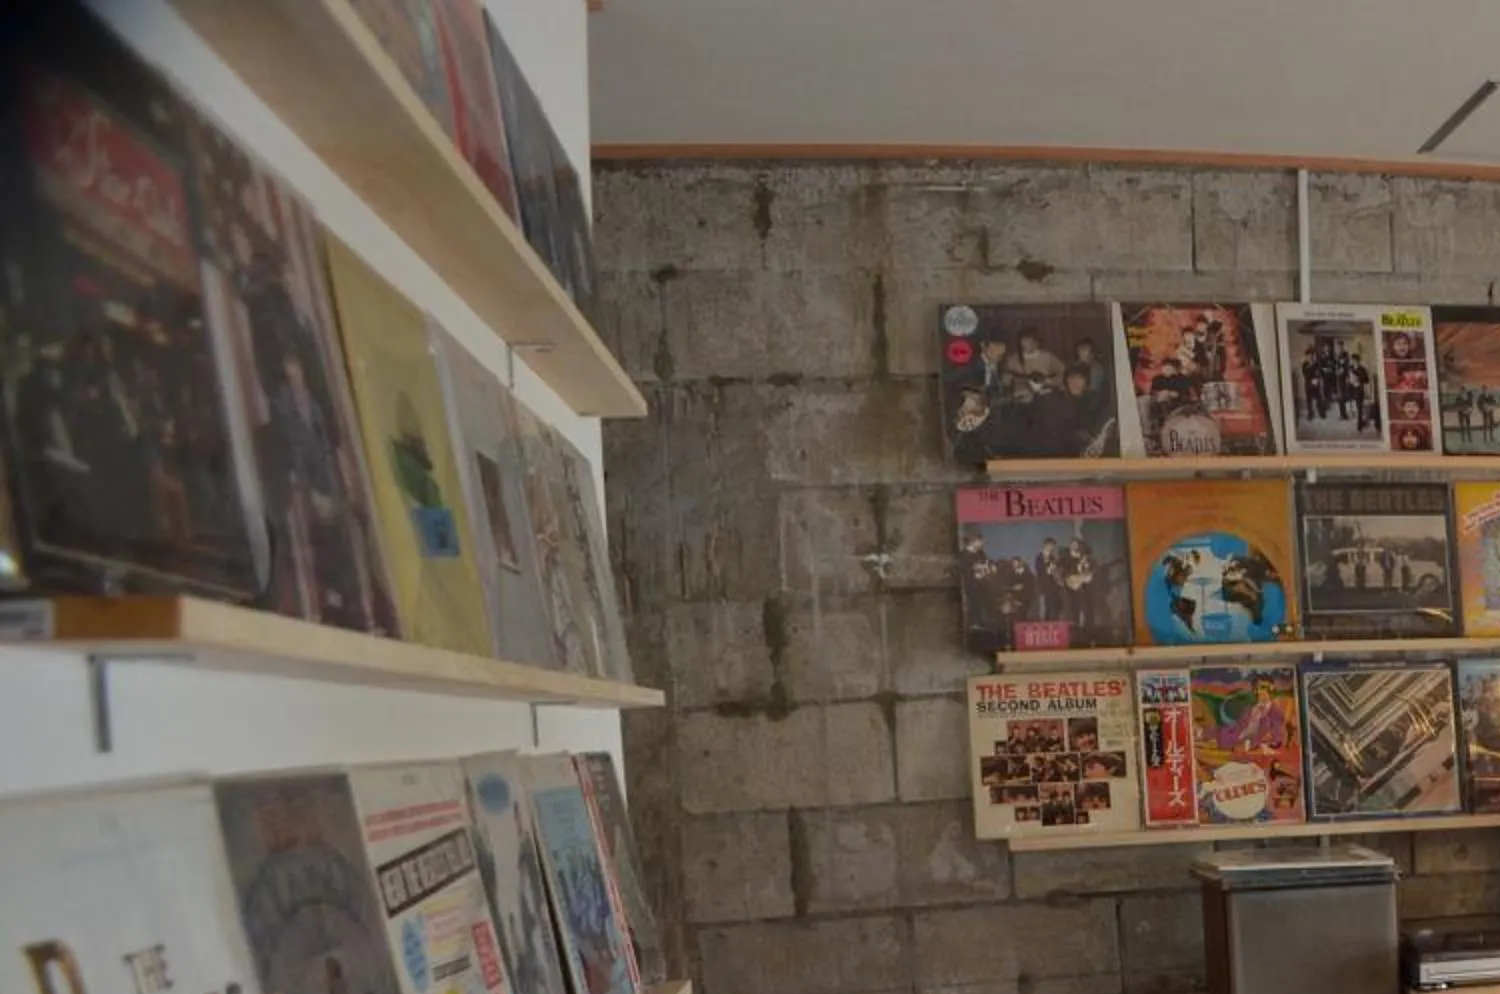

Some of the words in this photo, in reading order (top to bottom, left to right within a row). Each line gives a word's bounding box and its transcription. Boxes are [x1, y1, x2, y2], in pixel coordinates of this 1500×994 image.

[1005, 489, 1104, 517] BEATLES
[1303, 488, 1344, 511] THE
[976, 683, 1018, 700] THE
[976, 699, 1040, 713] SECOND
[1047, 697, 1097, 711] ALBUM
